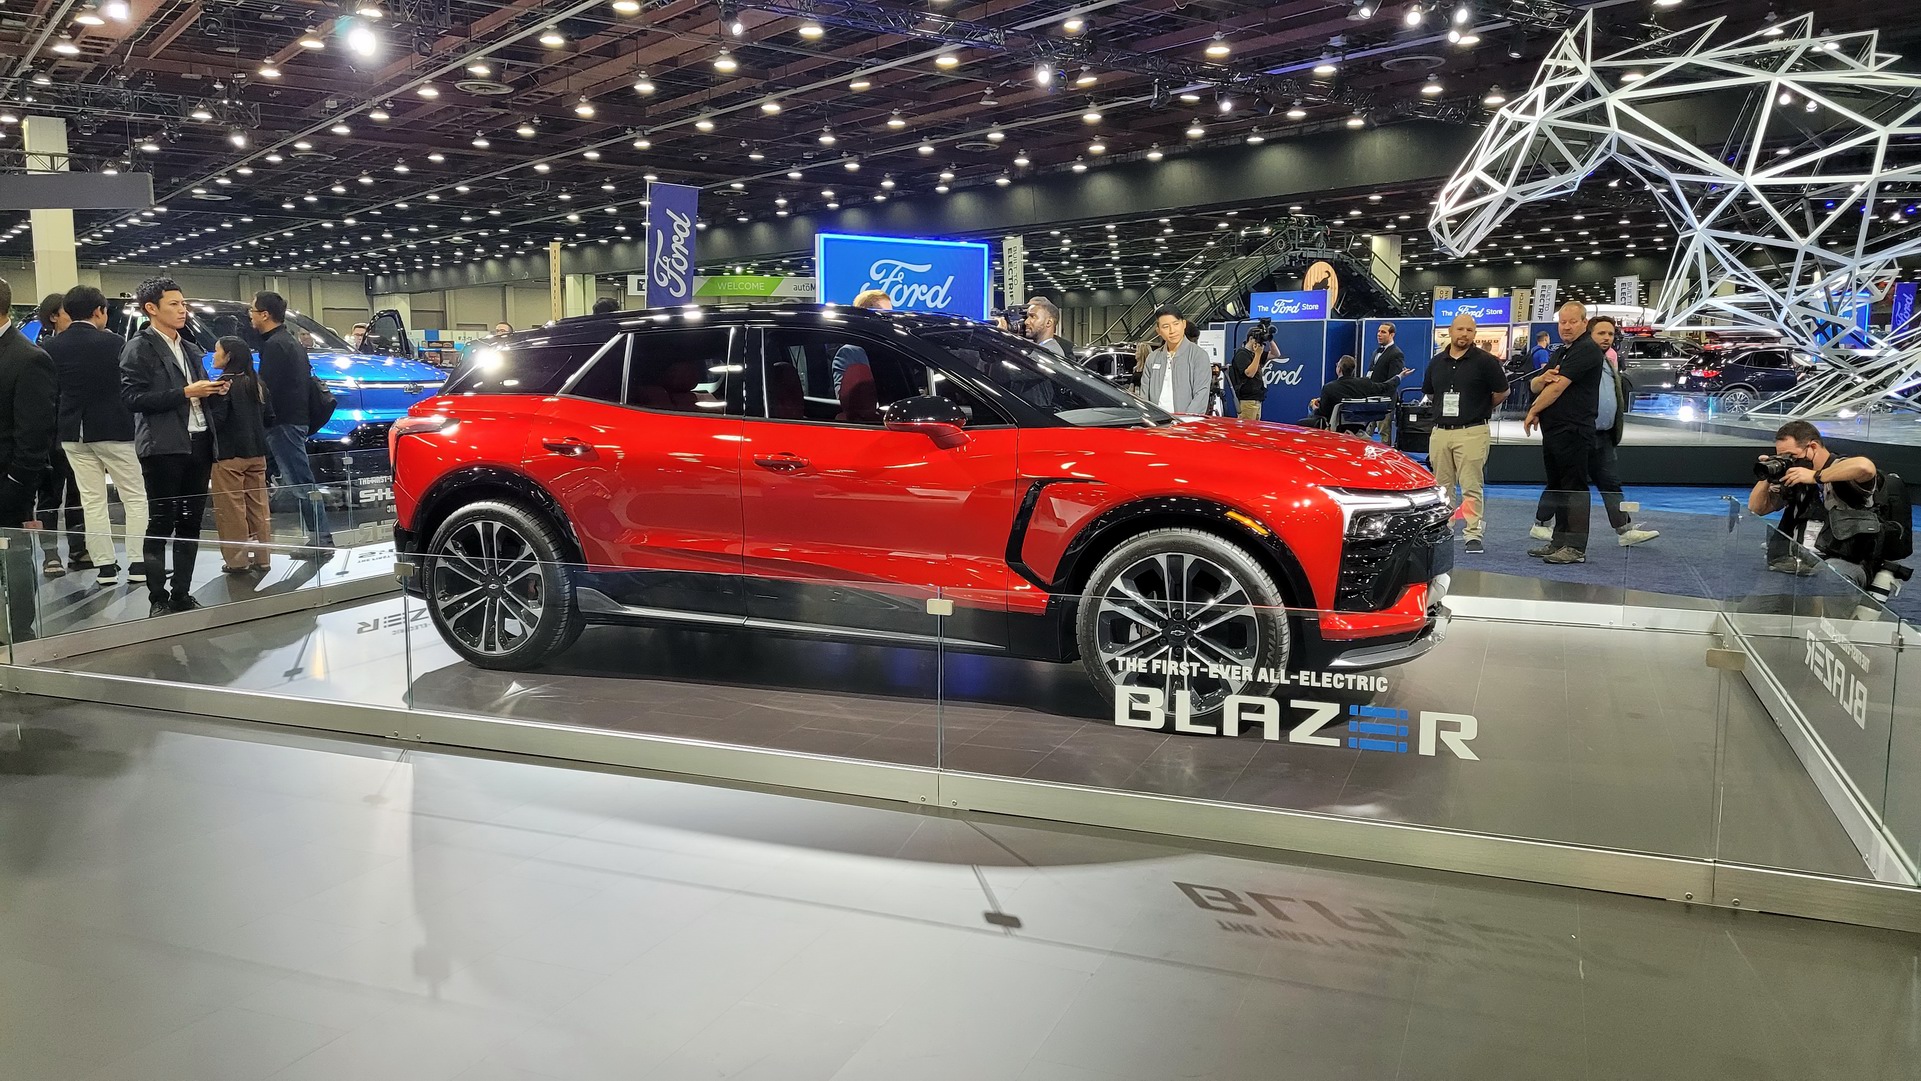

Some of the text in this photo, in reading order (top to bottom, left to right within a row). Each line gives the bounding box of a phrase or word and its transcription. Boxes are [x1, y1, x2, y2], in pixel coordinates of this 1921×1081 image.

[653, 208, 691, 298] Ford
[717, 281, 765, 291] WELCOME
[860, 259, 954, 309] Ford
[1271, 298, 1301, 314] Ford
[1301, 303, 1319, 311] Store
[1455, 304, 1485, 318] Ford
[1537, 285, 1546, 321] ELECTRIF
[1895, 292, 1914, 331] Ford
[1116, 656, 1389, 693] THE FIRST-EVER ALL-ELECTRIC
[1115, 685, 1480, 761] BLAZER
